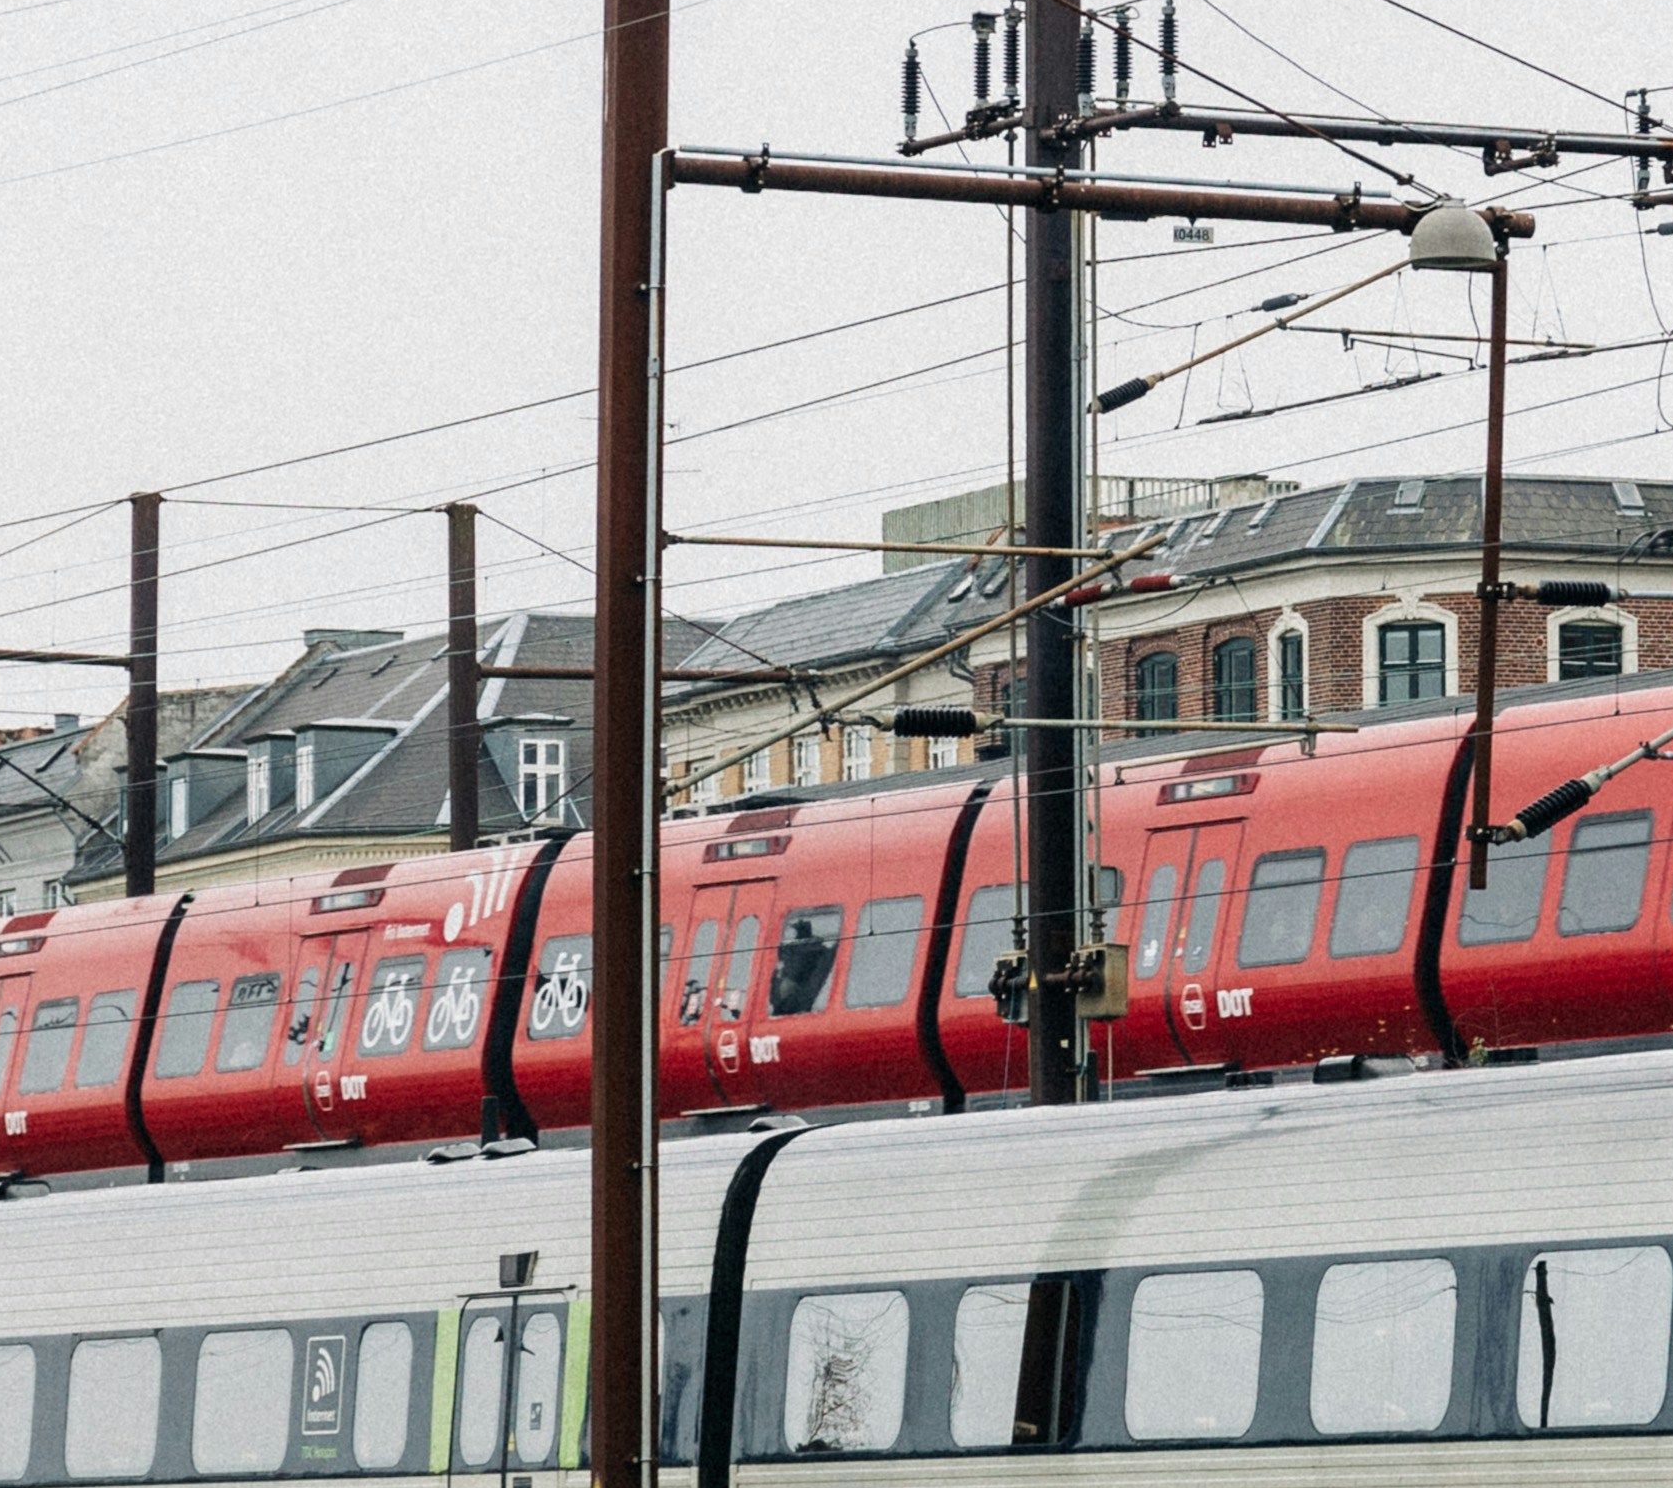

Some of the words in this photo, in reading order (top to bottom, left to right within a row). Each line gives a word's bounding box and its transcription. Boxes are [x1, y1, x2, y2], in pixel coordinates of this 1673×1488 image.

[1216, 988, 1254, 1018] DOT
[748, 1035, 781, 1064] DOT
[340, 1075, 368, 1101] DOT
[4, 1110, 28, 1136] DOT
